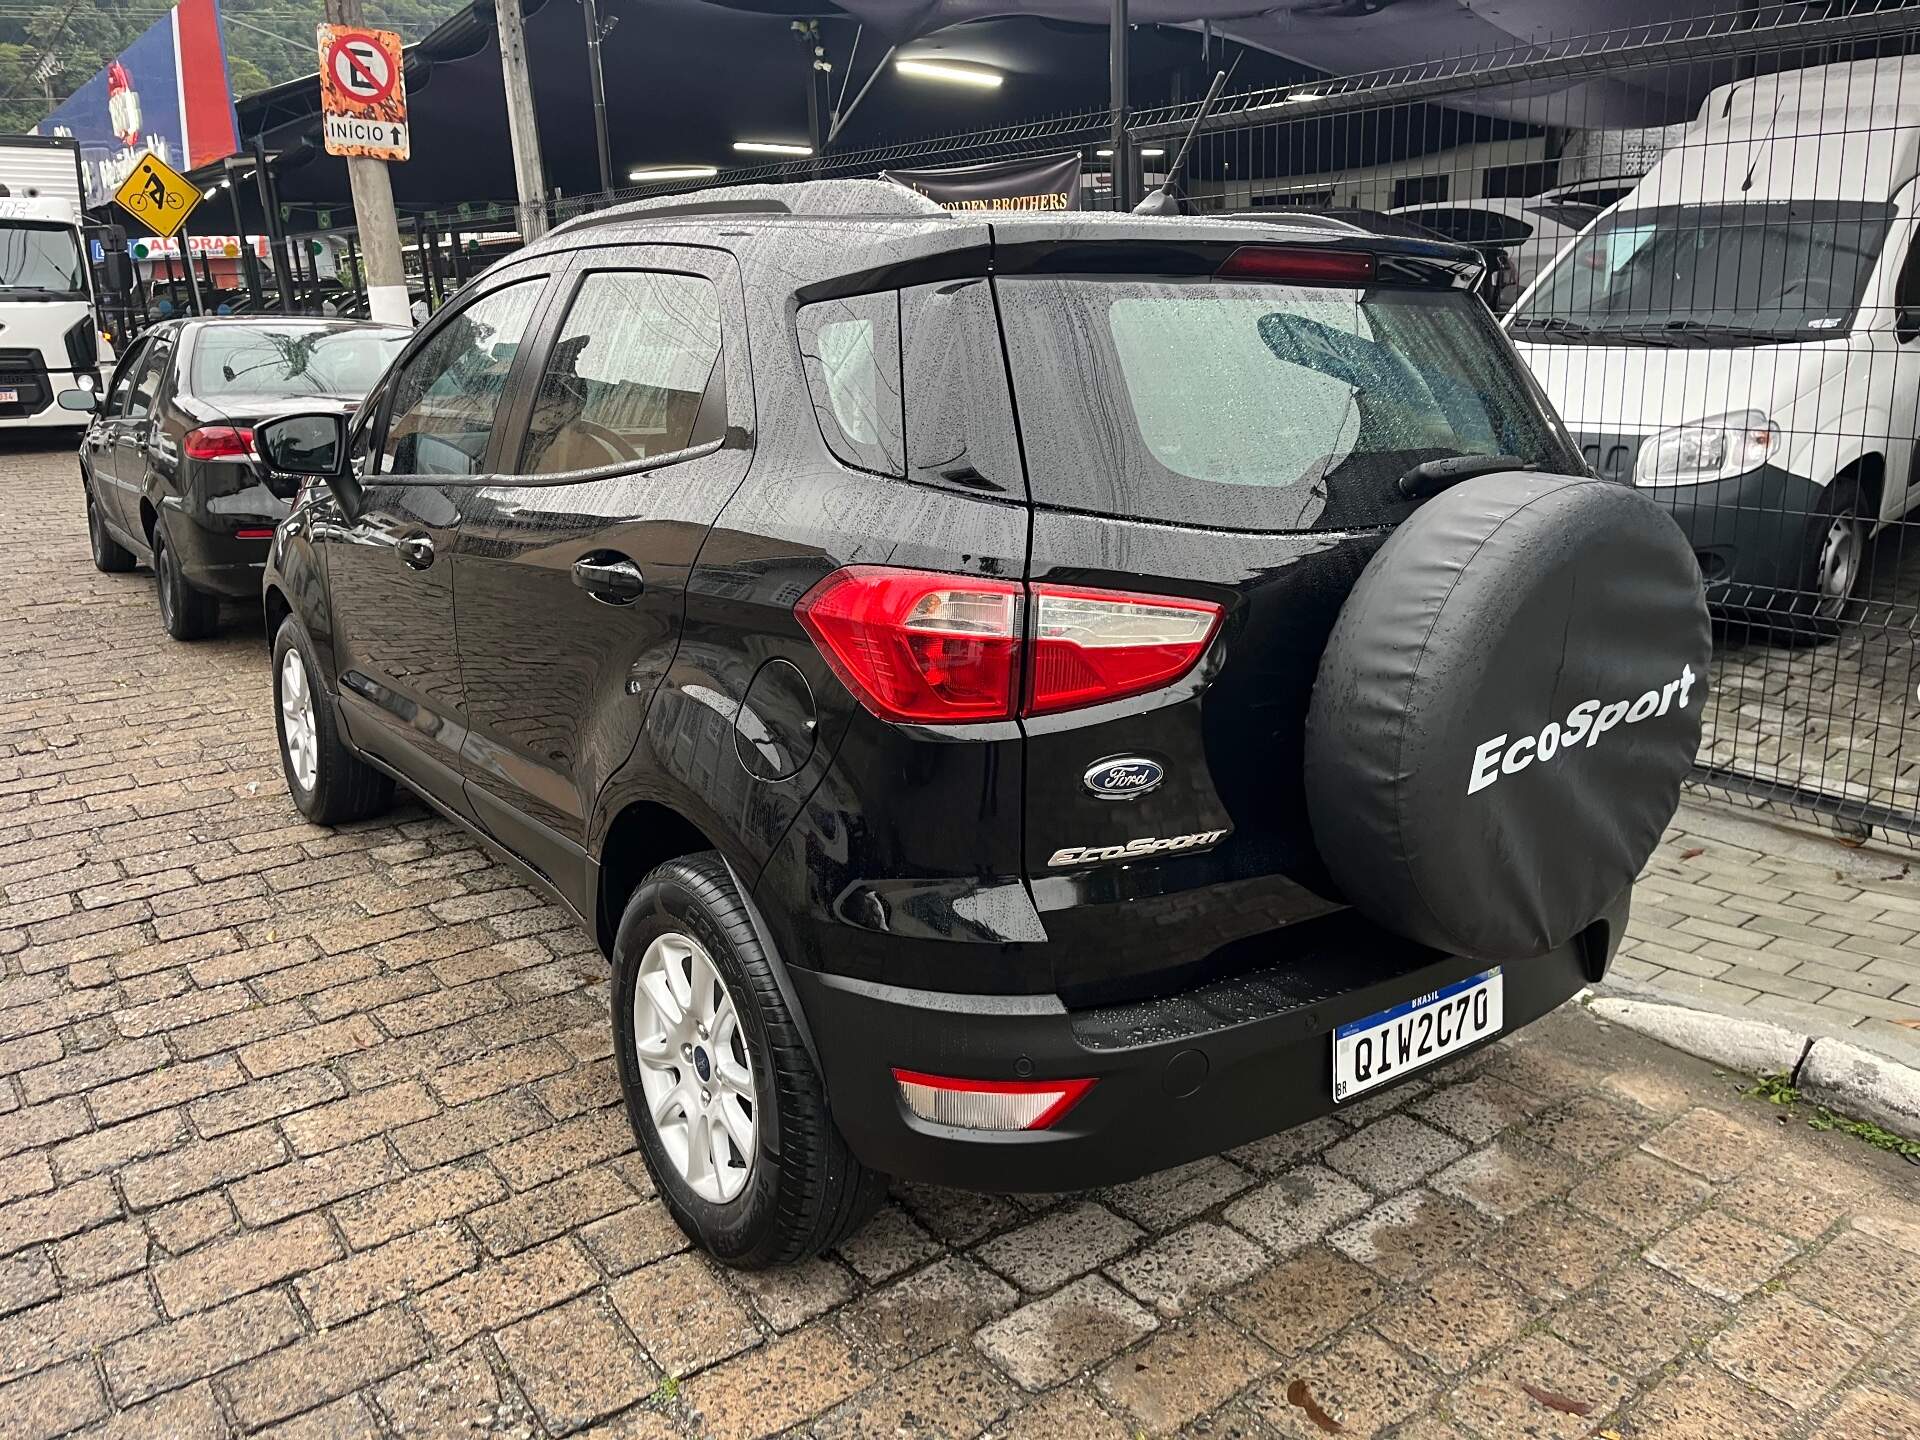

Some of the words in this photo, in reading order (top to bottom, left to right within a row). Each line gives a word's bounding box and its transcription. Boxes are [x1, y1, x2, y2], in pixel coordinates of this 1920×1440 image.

[330, 121, 383, 141] INÍCIO
[992, 193, 1068, 211] BROTHERS
[1467, 663, 1696, 796] EcoSport
[1104, 765, 1150, 789] Ford
[1411, 989, 1440, 1010] BRASIL
[1355, 987, 1488, 1083] QIW2C70
[1335, 1080, 1348, 1097] BR
